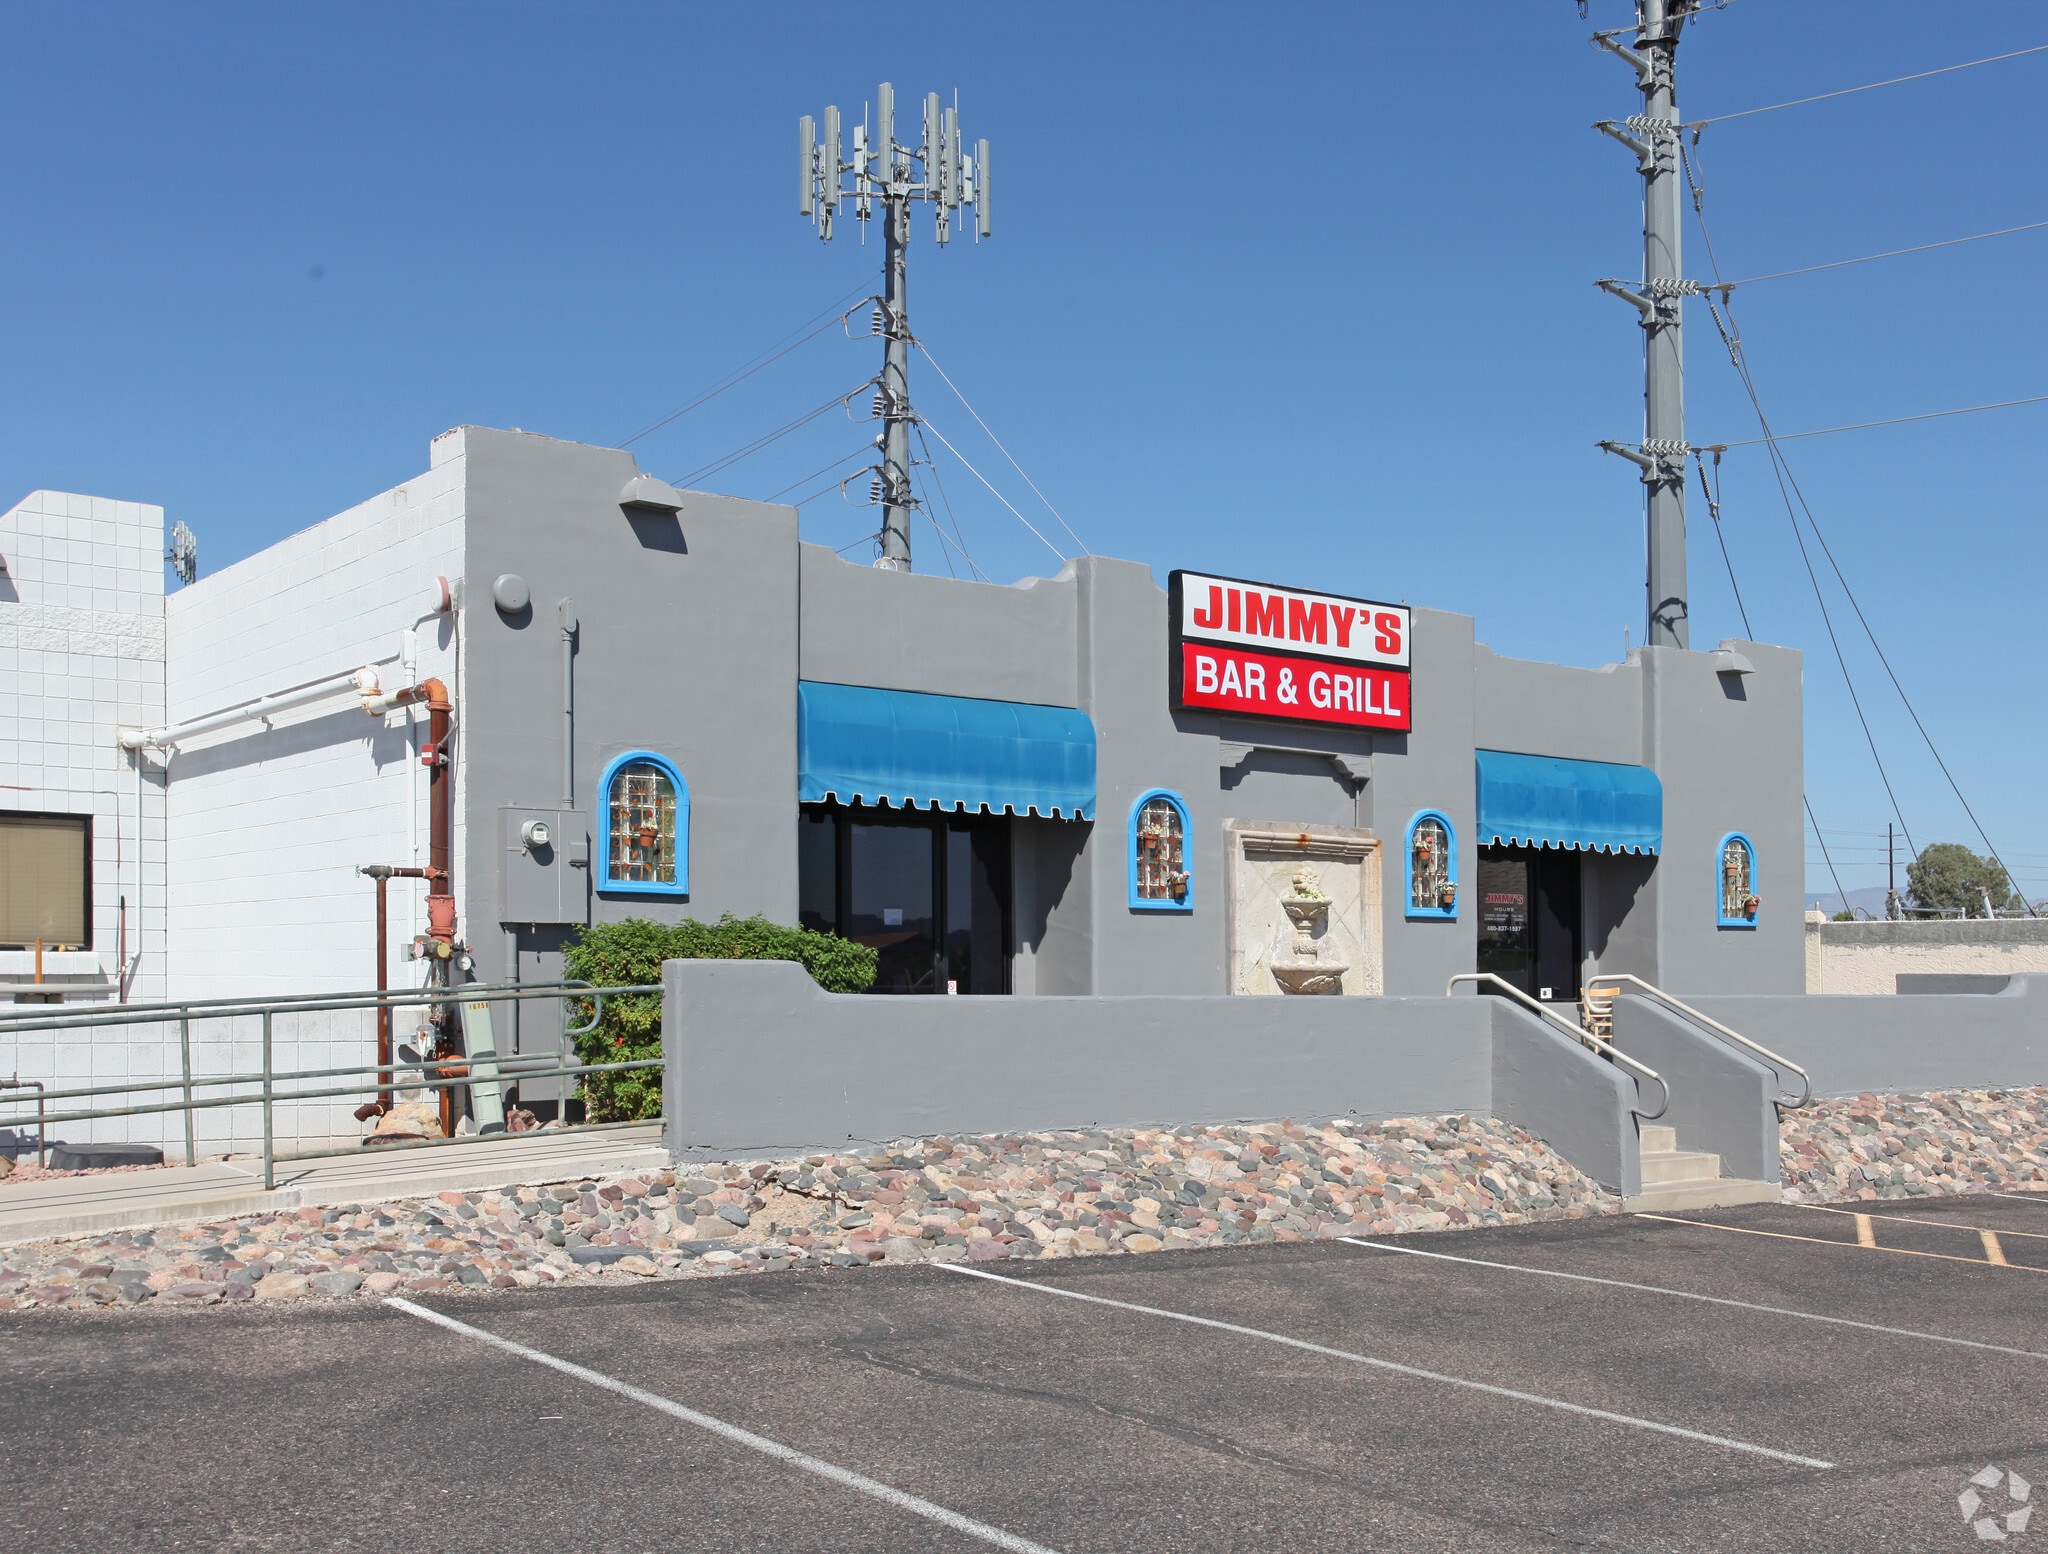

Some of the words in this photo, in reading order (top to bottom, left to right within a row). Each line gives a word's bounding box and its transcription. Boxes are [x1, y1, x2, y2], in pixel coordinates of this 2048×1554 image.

[1193, 585, 1401, 655] JIMMY'S
[1195, 655, 1267, 701] BAR
[1276, 667, 1299, 705] &
[1308, 671, 1401, 717] GRILL
[1485, 893, 1524, 904] JIMMY'S
